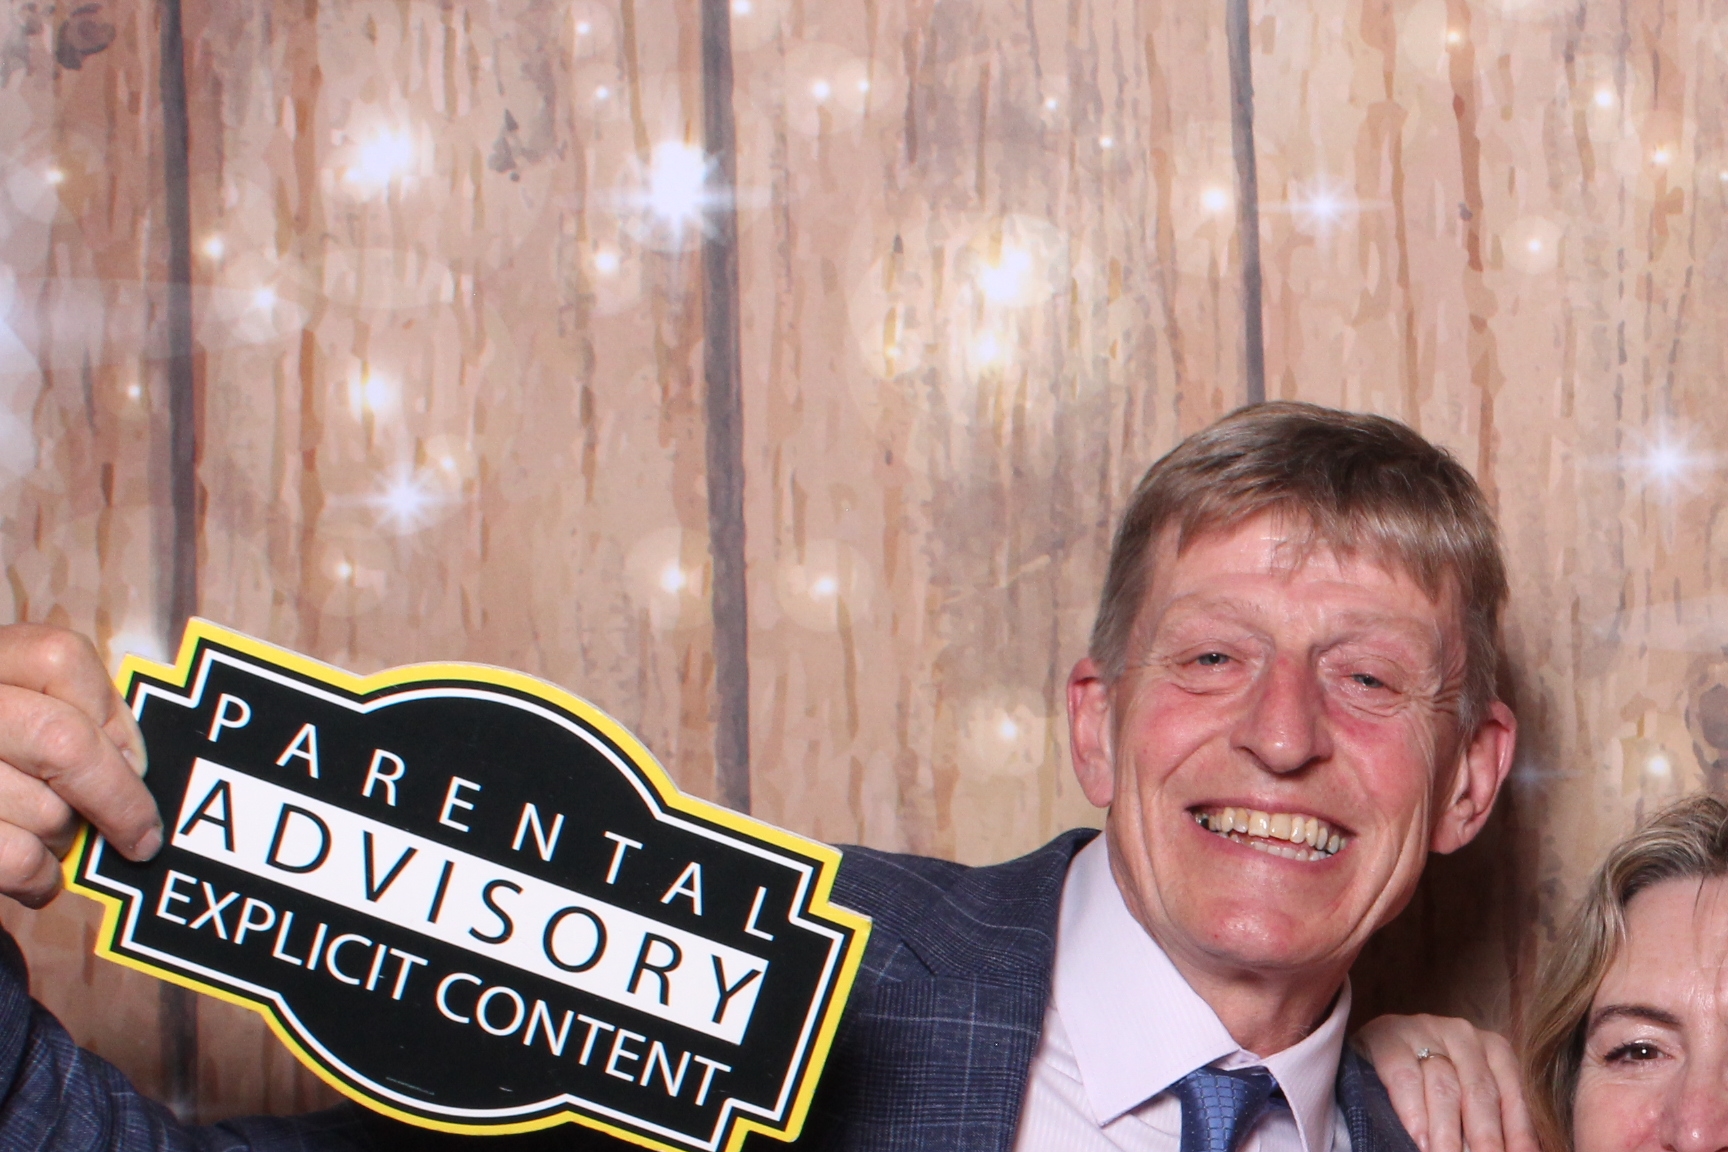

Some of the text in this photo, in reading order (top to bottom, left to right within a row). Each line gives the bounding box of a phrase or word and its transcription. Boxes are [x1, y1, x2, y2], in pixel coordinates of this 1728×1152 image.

[178, 778, 763, 1027] ADVISORY
[206, 692, 775, 942] PARENTAL
[155, 870, 732, 1107] EXPLICIT CONTENT
